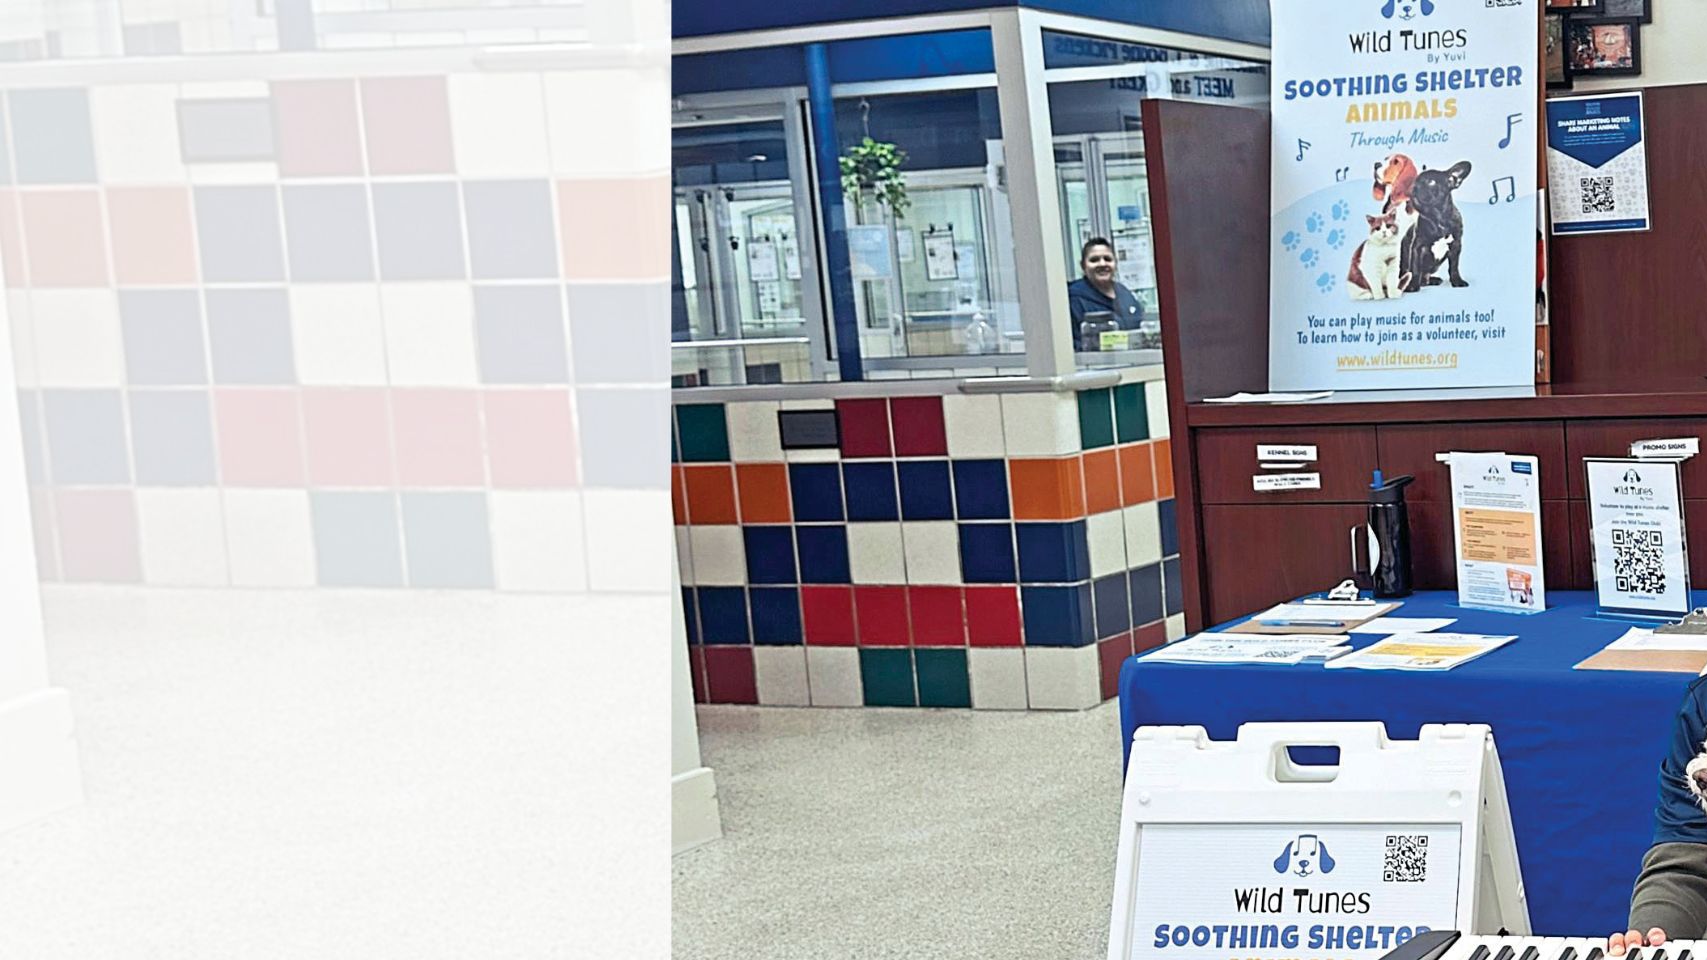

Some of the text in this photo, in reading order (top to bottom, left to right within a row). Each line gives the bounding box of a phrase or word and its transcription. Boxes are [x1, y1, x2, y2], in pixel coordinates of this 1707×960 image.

[1349, 28, 1467, 53] Wild Tunes
[1427, 52, 1466, 64] By Yuvi
[1284, 66, 1522, 100] SOOTHING SHELTER
[1345, 98, 1457, 123] ANIMALS
[1350, 128, 1449, 150] Through Music
[1308, 309, 1494, 330] You can play music for animals too!
[1297, 326, 1506, 346] To learn how to join as a volunteer, visit
[1336, 350, 1458, 369] www.wildtunes.org
[1643, 443, 1666, 451] PROMO
[1234, 887, 1370, 914] Wild Tunes
[1154, 924, 1299, 949] SOOTHING
